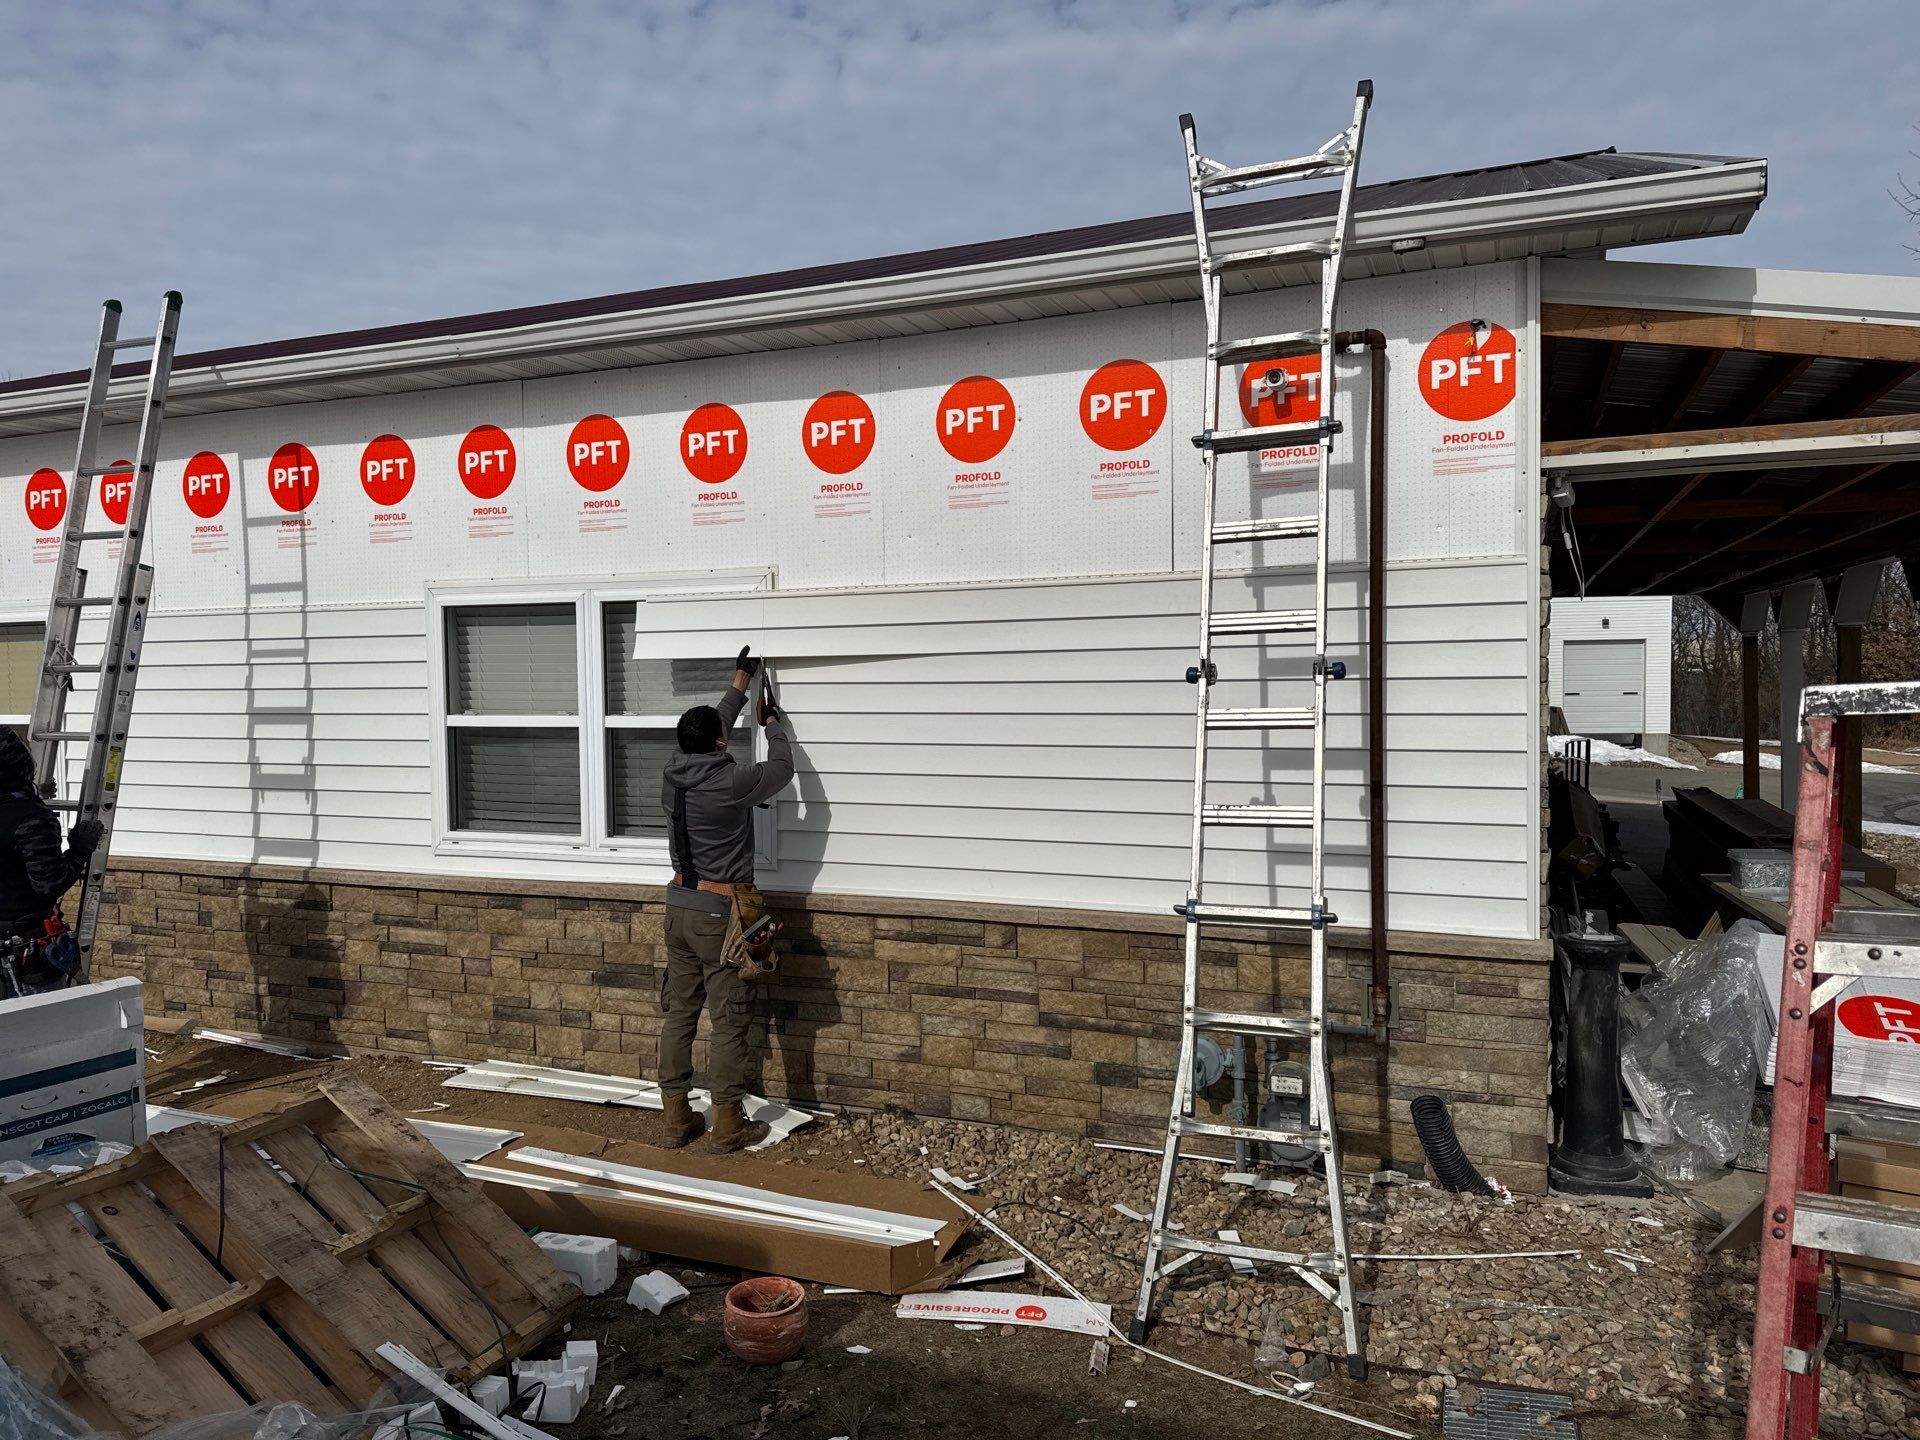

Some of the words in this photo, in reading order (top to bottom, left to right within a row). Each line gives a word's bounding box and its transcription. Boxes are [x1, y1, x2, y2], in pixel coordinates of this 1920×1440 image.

[1431, 352, 1511, 390] PFT
[1090, 388, 1156, 422] PFT
[945, 404, 1005, 435] PFT
[810, 417, 866, 447] PFT
[1443, 430, 1504, 444] PROFOLD
[688, 429, 739, 457] PFT
[1470, 442, 1516, 451] Underlayment
[574, 439, 621, 467] PFT
[1262, 446, 1317, 460] PROFOLD
[465, 449, 509, 475] PFT
[1100, 460, 1150, 472] PROFOLD
[366, 457, 408, 482] PFT
[274, 465, 313, 489] PFT
[955, 472, 1001, 483] PROFOLD
[189, 473, 224, 496] PFT
[821, 482, 863, 493] PROFOLD
[30, 488, 62, 510] PFT
[698, 491, 737, 501] PROFOLD
[473, 506, 507, 515] PROFOLD
[584, 500, 620, 509] PROFOLD
[282, 519, 312, 527] PROFOLD
[374, 513, 406, 521] PROFOLD
[195, 525, 223, 533] PROFOLD
[45, 1112, 69, 1125] CAP
[1017, 1310, 1044, 1319] PFT
